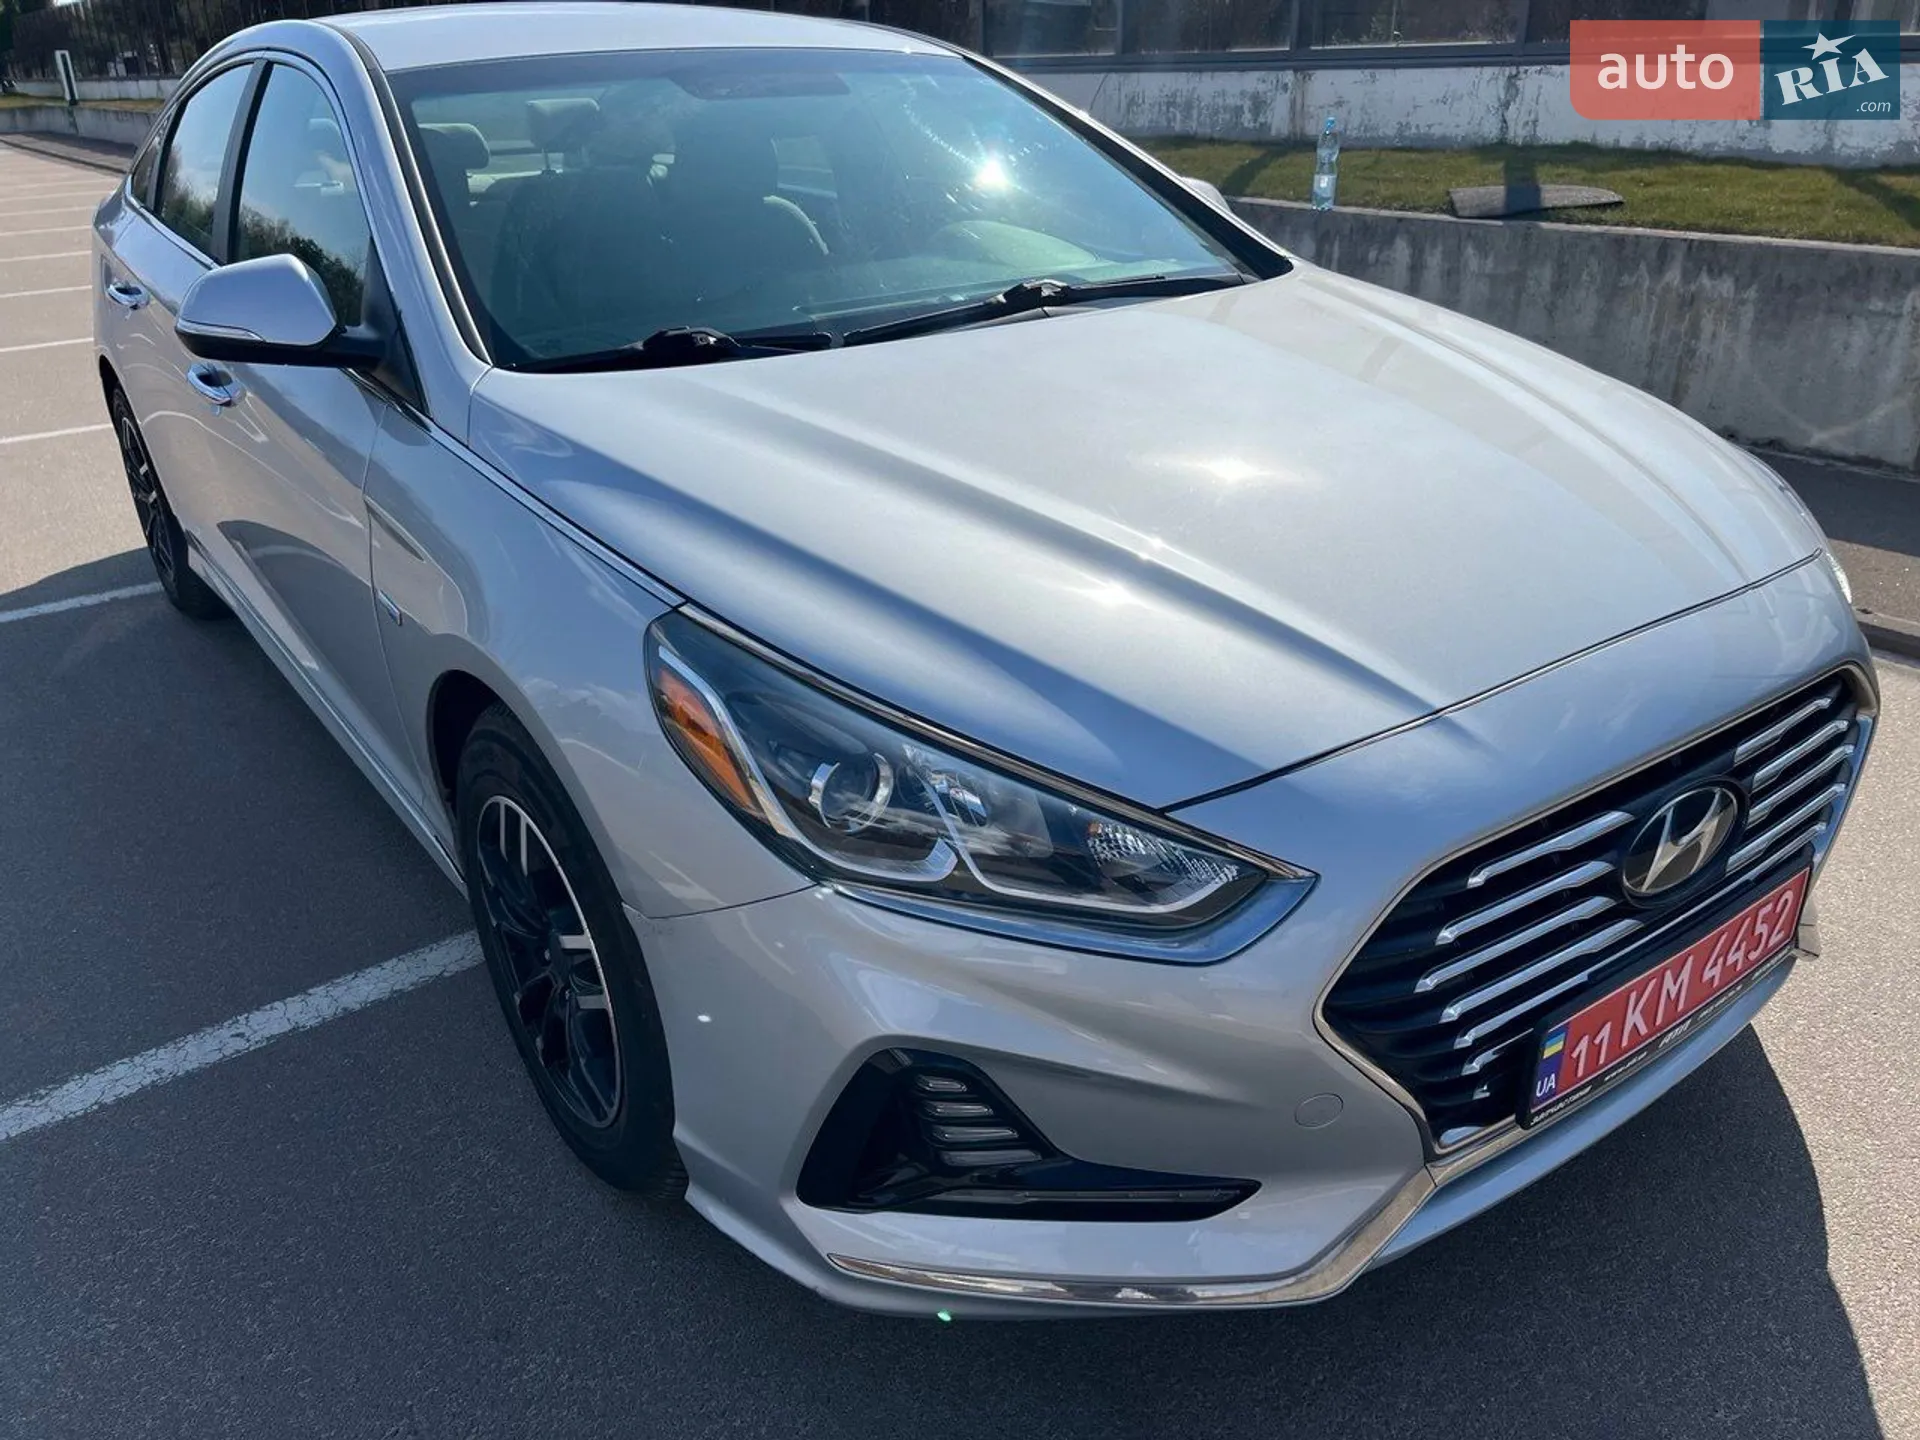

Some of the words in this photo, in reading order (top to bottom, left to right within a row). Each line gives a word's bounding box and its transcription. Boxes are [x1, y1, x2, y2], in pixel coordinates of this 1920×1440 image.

[1570, 1020, 1613, 1078] 11
[1620, 954, 1694, 1048] KM
[1701, 889, 1794, 989] 4452
[1535, 1072, 1557, 1098] UA
